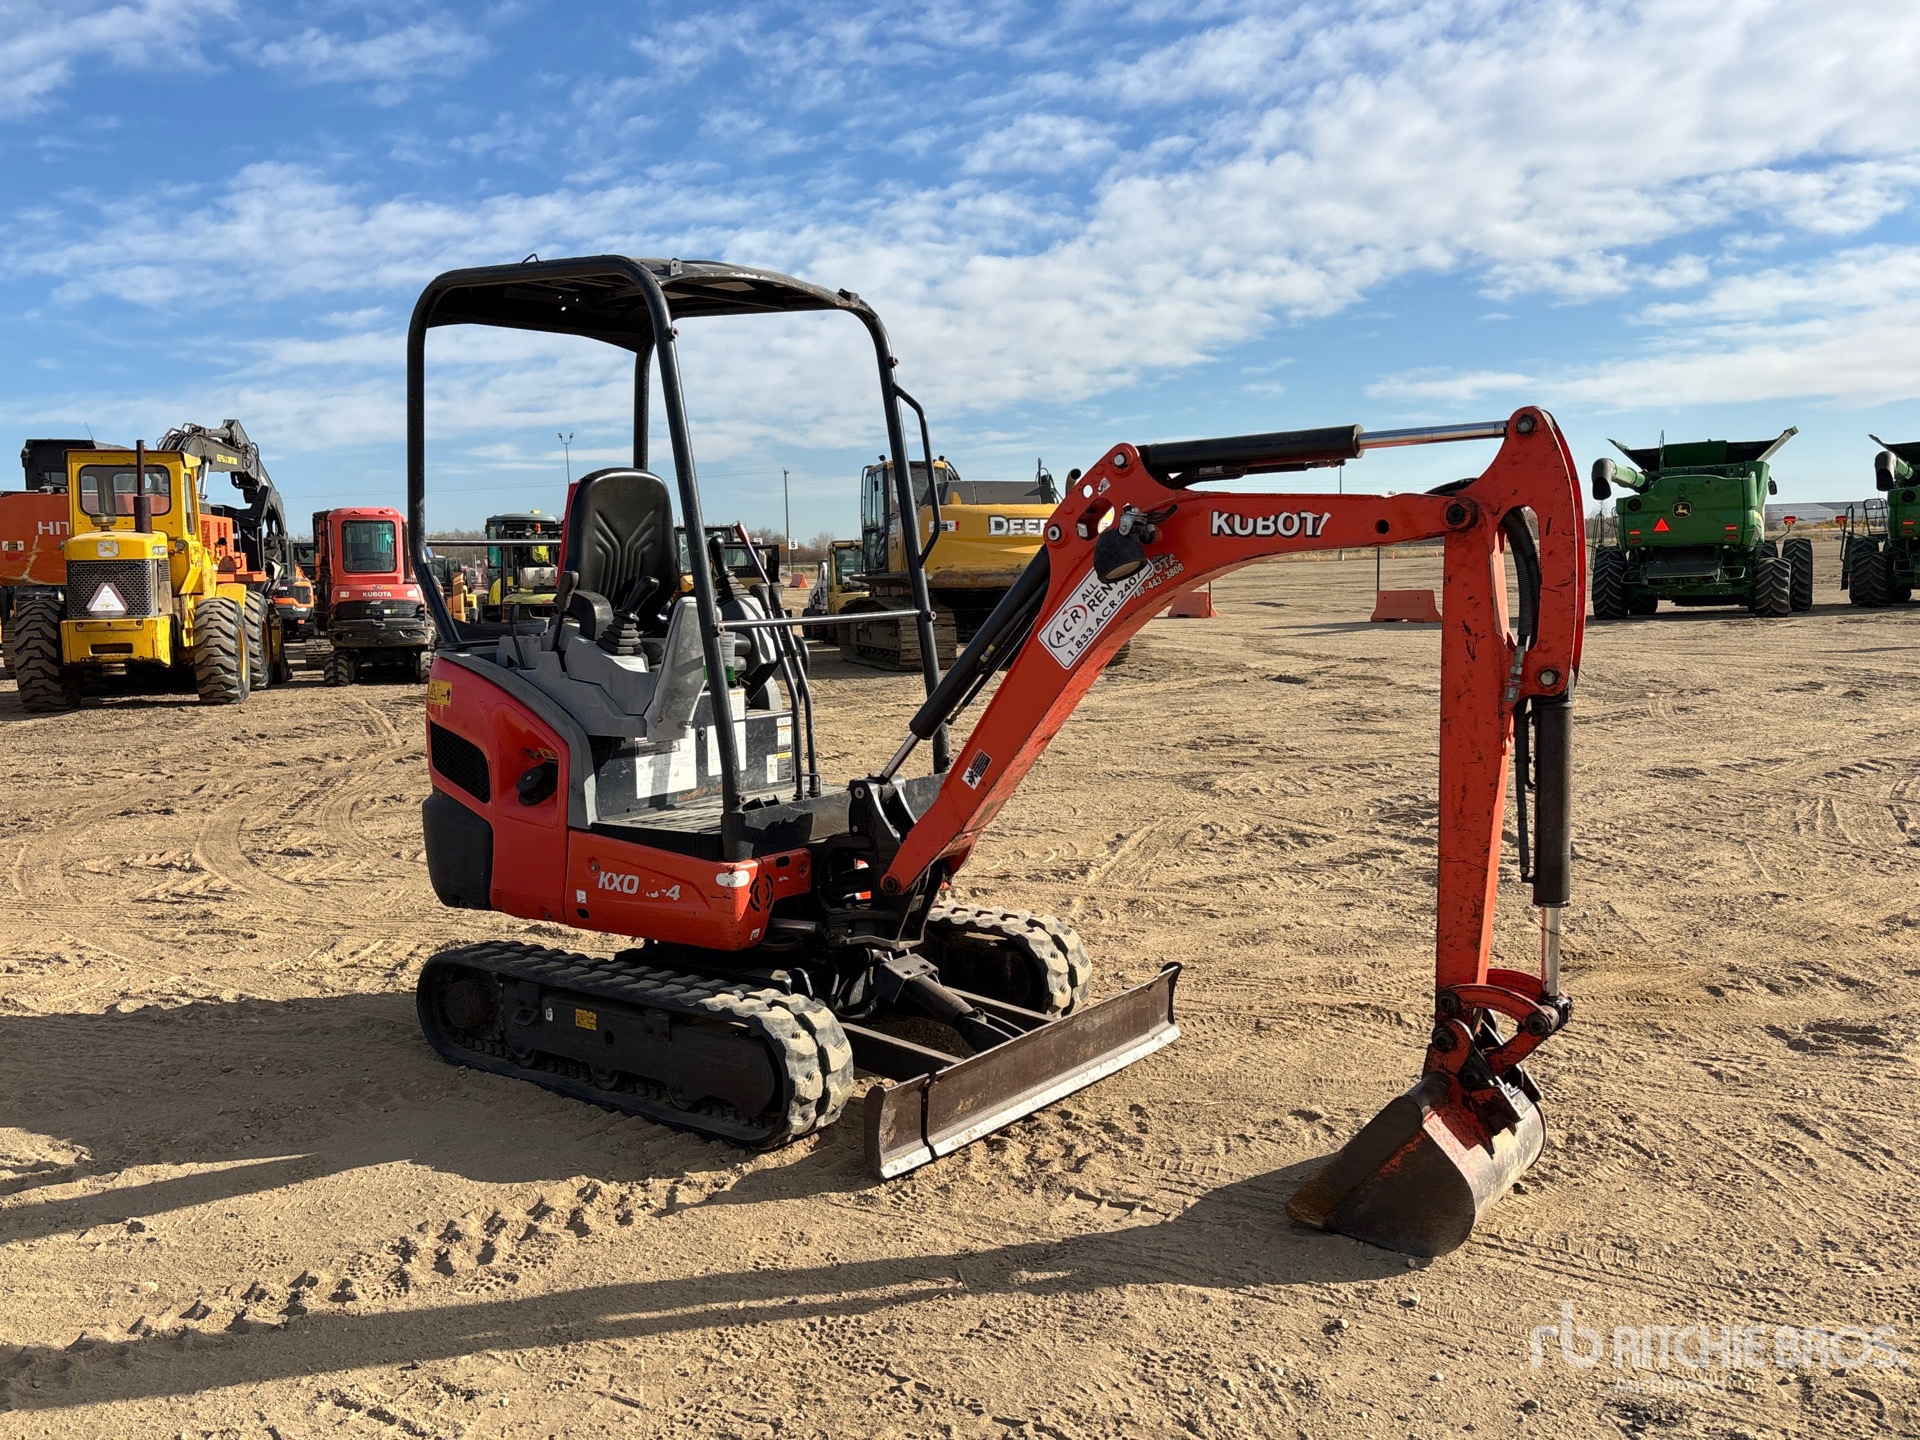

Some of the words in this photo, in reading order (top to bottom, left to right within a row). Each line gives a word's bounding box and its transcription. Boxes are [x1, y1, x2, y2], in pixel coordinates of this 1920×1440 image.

[790, 540, 796, 549] 5
[1081, 582, 1099, 603] ALL
[1087, 579, 1119, 613] REN
[1054, 608, 1082, 645] ACR
